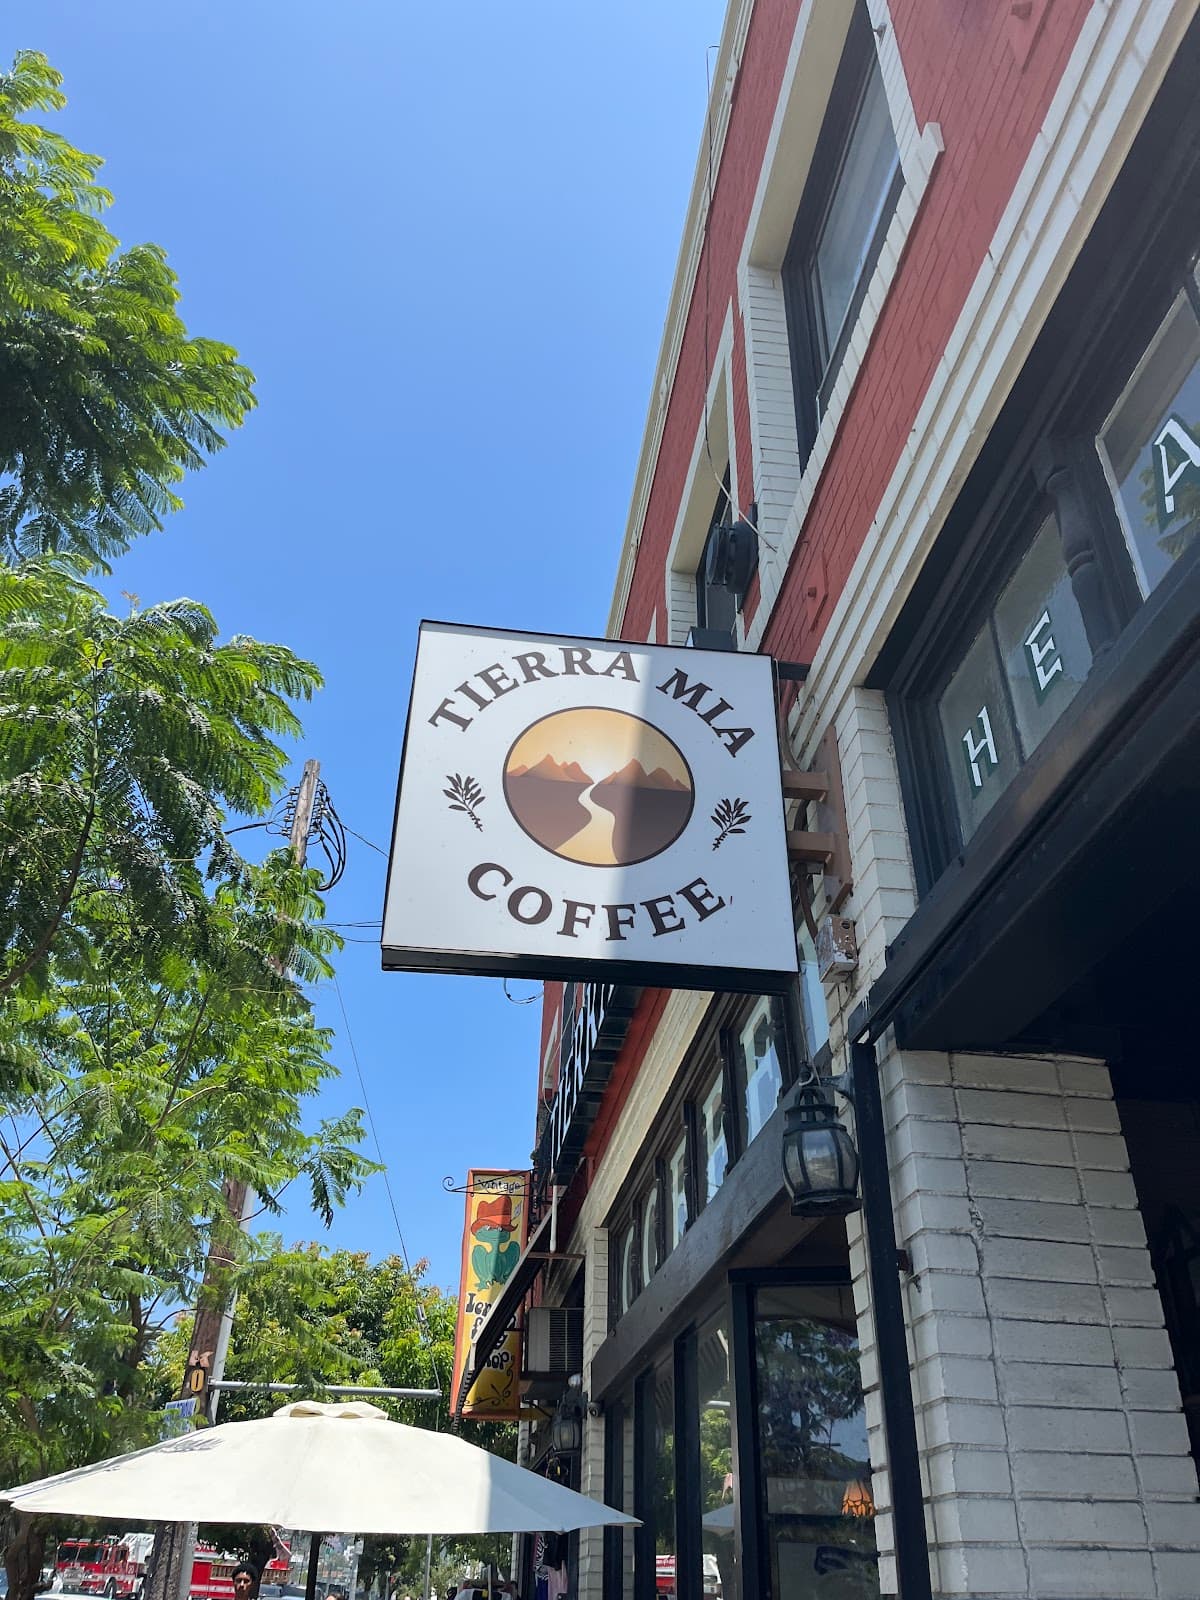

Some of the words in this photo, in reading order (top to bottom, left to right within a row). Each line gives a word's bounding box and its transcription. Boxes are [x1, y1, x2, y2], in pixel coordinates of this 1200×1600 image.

[428, 647, 640, 733] TIERRA
[656, 668, 755, 757] MIA
[467, 862, 725, 941] COFFEE
